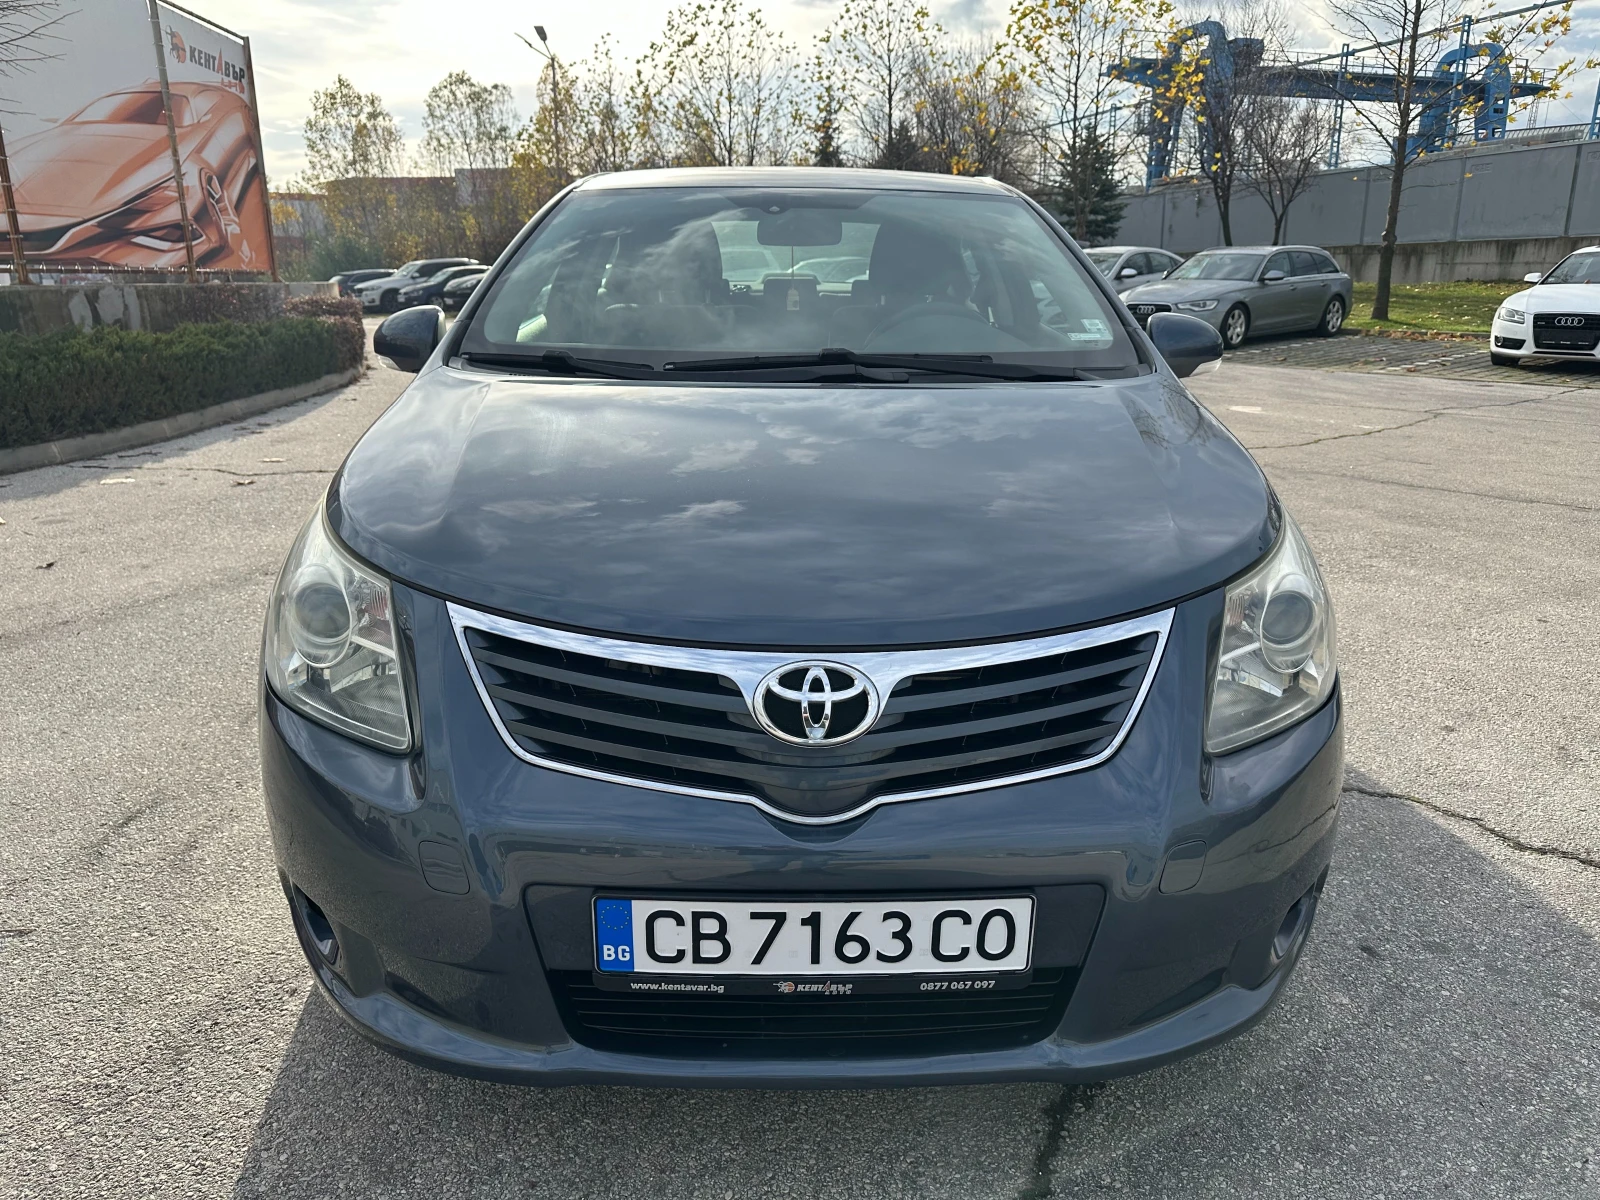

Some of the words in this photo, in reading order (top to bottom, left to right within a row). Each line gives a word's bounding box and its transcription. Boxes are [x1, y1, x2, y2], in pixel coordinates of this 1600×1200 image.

[645, 909, 731, 964] CB
[749, 911, 913, 965] 7163
[603, 944, 631, 961] BG
[630, 982, 725, 993] www.kentavar.bg
[920, 982, 949, 991] 0877
[950, 981, 973, 990] 067
[974, 980, 996, 989] 097
